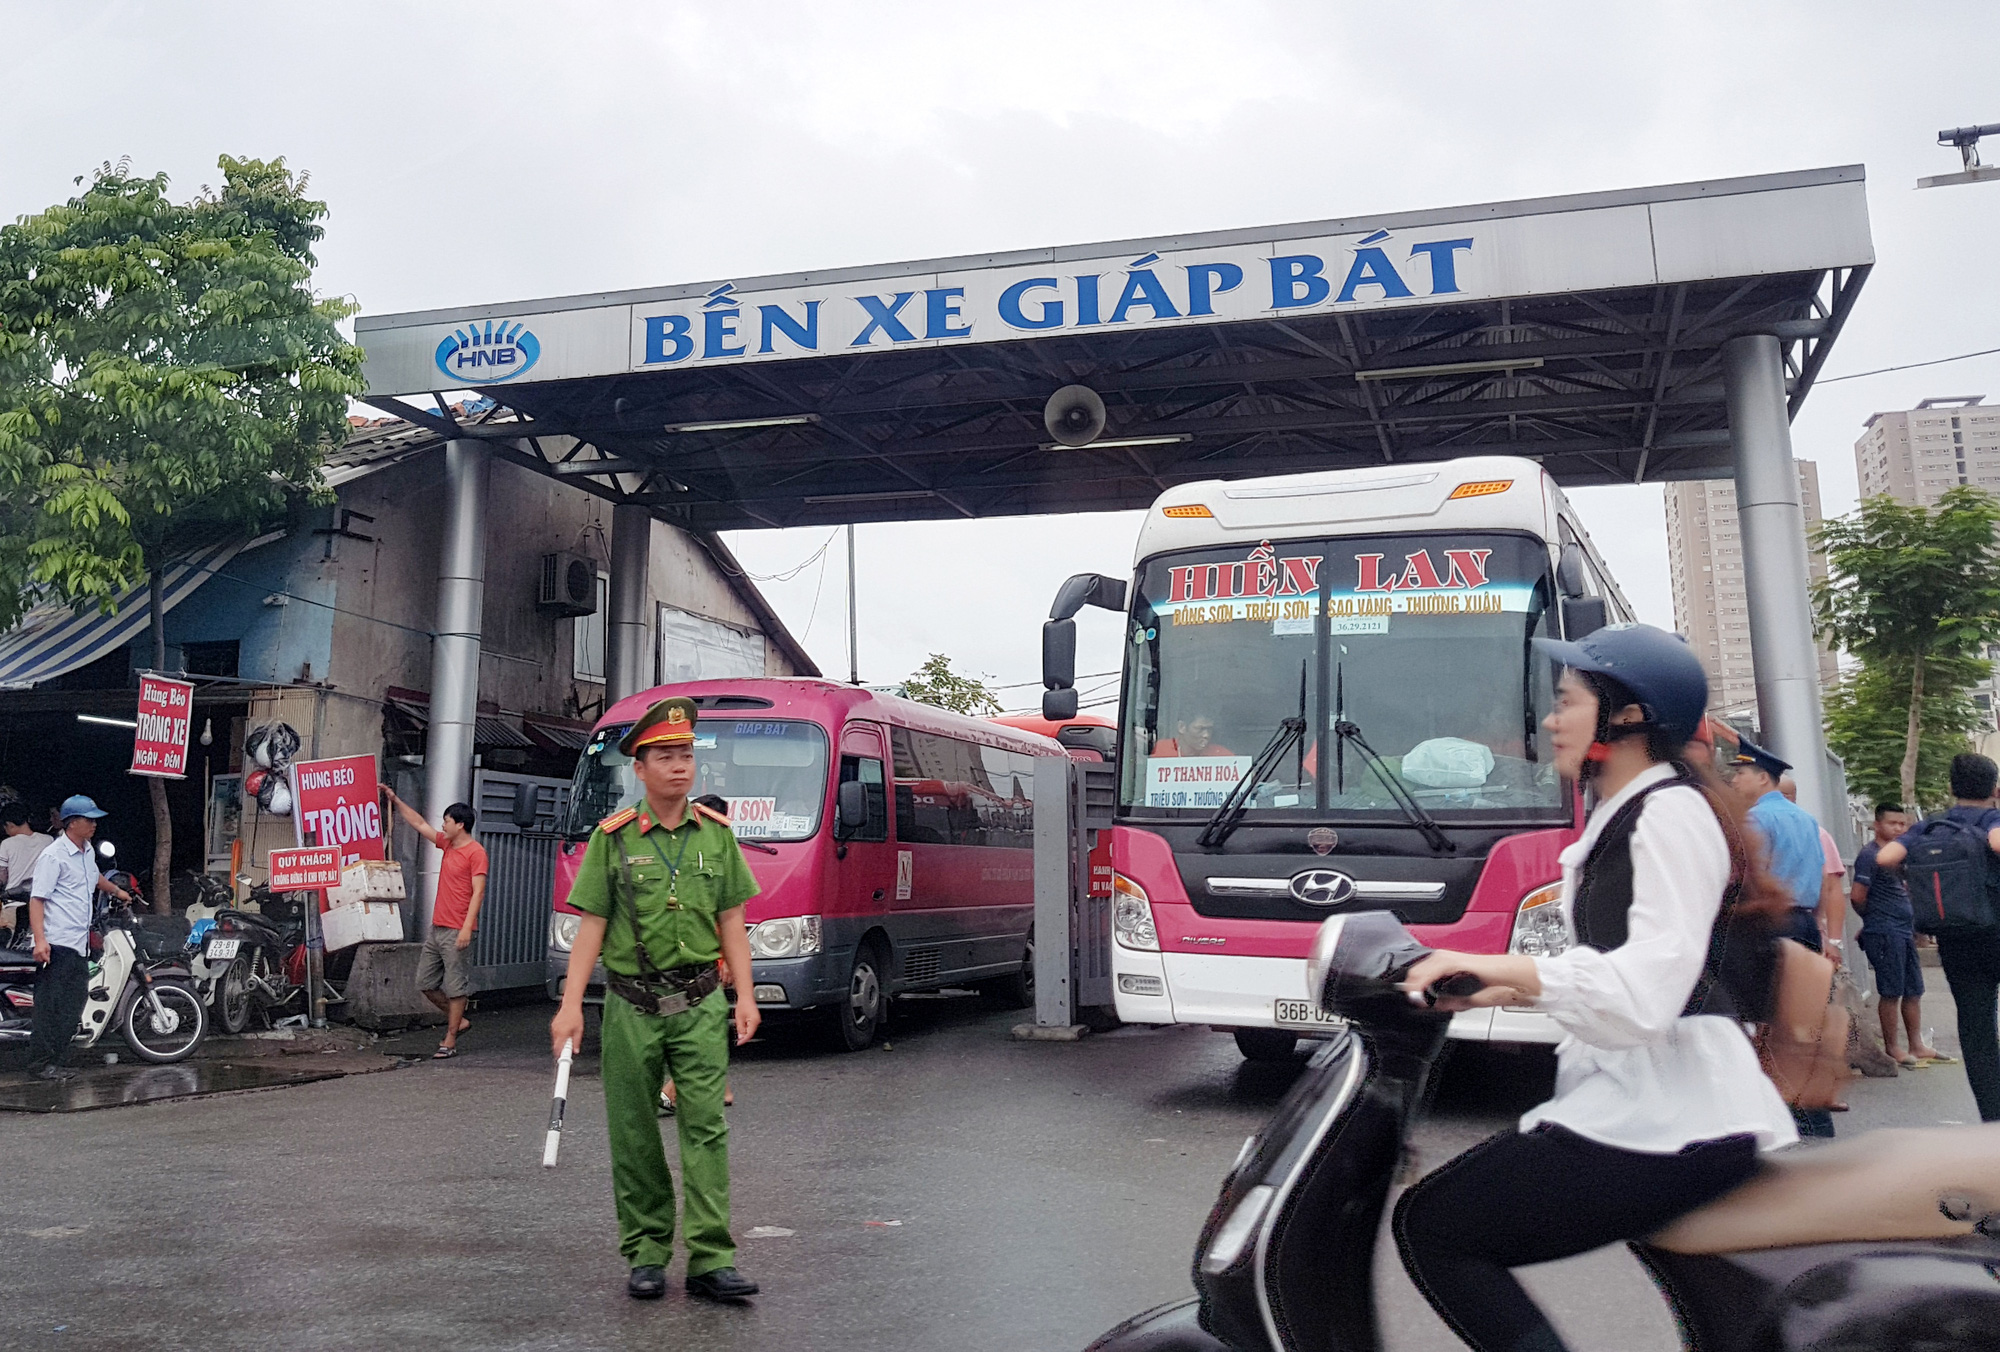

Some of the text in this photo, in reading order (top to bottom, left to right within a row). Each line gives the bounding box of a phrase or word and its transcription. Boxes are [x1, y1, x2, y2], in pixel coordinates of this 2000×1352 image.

[641, 229, 1475, 366] BẾN XE GIÁP BÁT
[457, 348, 516, 368] HNB
[1166, 540, 1493, 604] HIỀN LAN
[1208, 604, 1233, 623] SƠN
[1284, 600, 1309, 620] SƠN
[1327, 597, 1353, 618] SAO
[1357, 593, 1393, 616] VÀNG
[1464, 591, 1502, 615] XUÂN
[143, 683, 186, 708] Hùng Béo
[137, 709, 186, 746] TRÔNG XE
[135, 748, 158, 766] NGÀY
[301, 764, 354, 790] HÙNG BÉO
[1158, 761, 1240, 782] TP THANH HOÁ
[304, 796, 380, 847] TRÔNG
[740, 798, 773, 822] SƠN
[278, 854, 297, 868] QUÝ
[300, 852, 332, 866] KHÁCH
